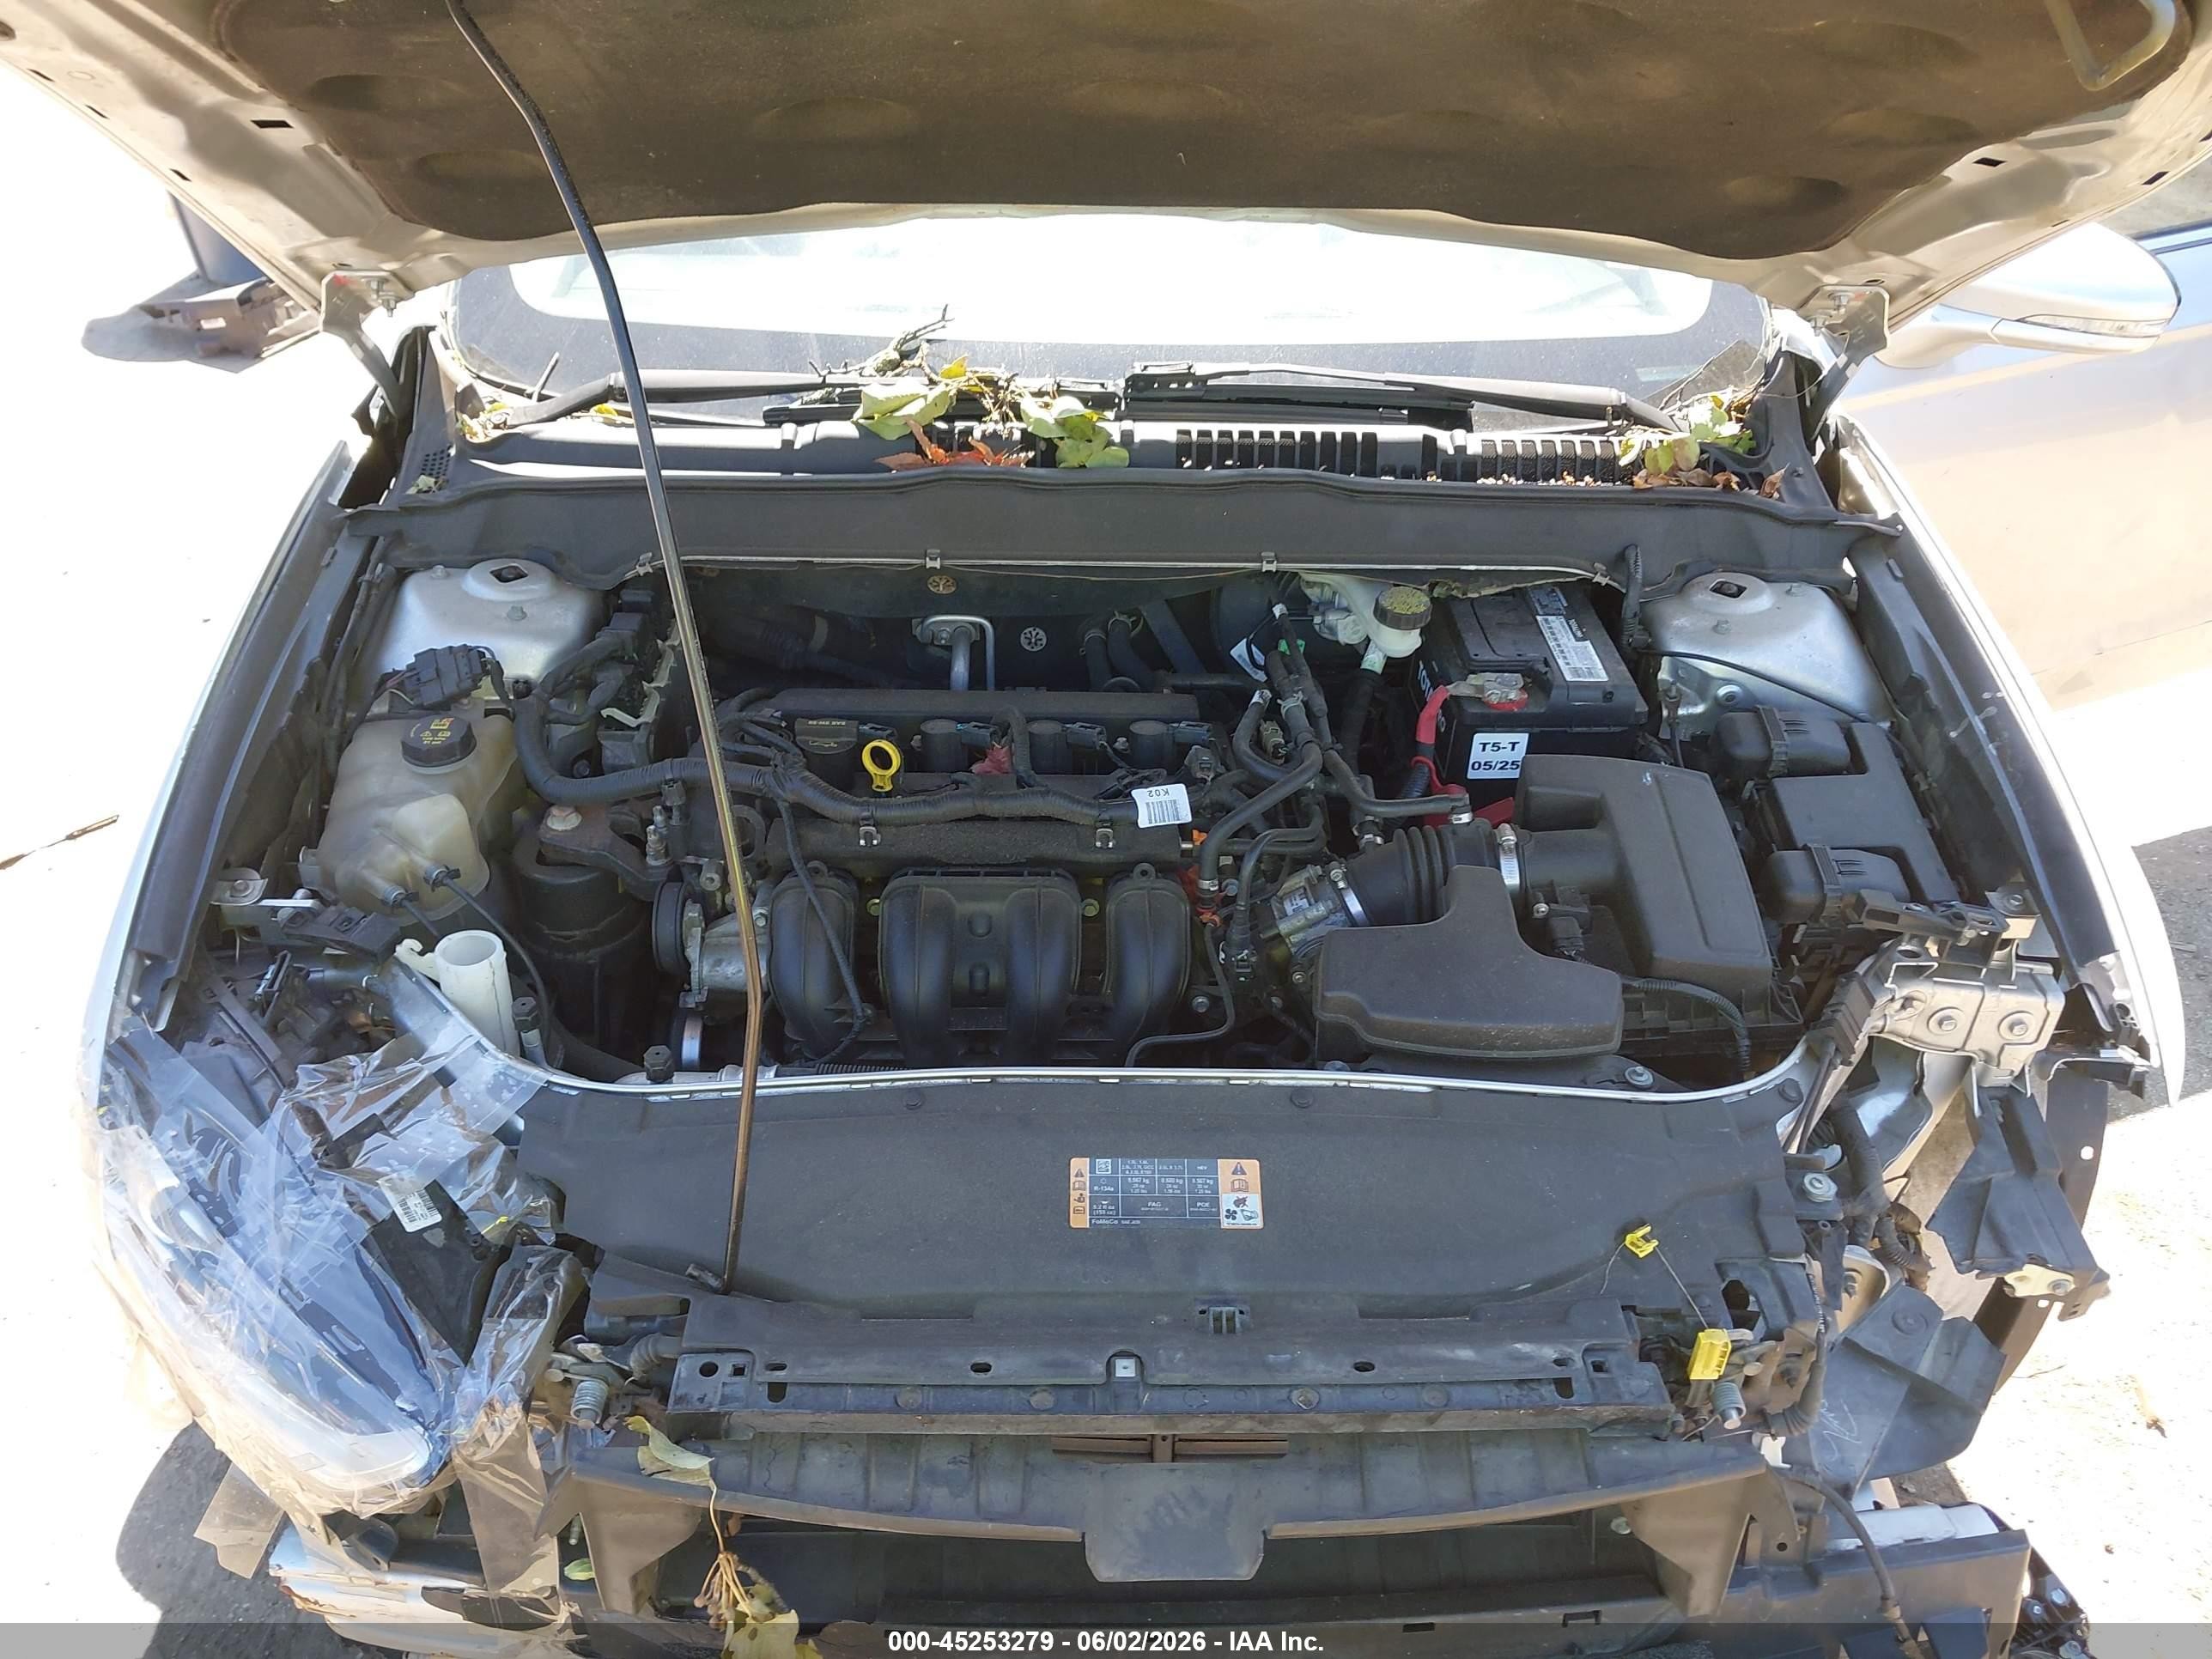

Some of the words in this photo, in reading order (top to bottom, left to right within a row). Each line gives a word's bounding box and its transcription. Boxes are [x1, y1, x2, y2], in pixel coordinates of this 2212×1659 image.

[1479, 741, 1520, 752] T5-T
[1470, 759, 1520, 771] 05/25
[1147, 788, 1170, 798] K02
